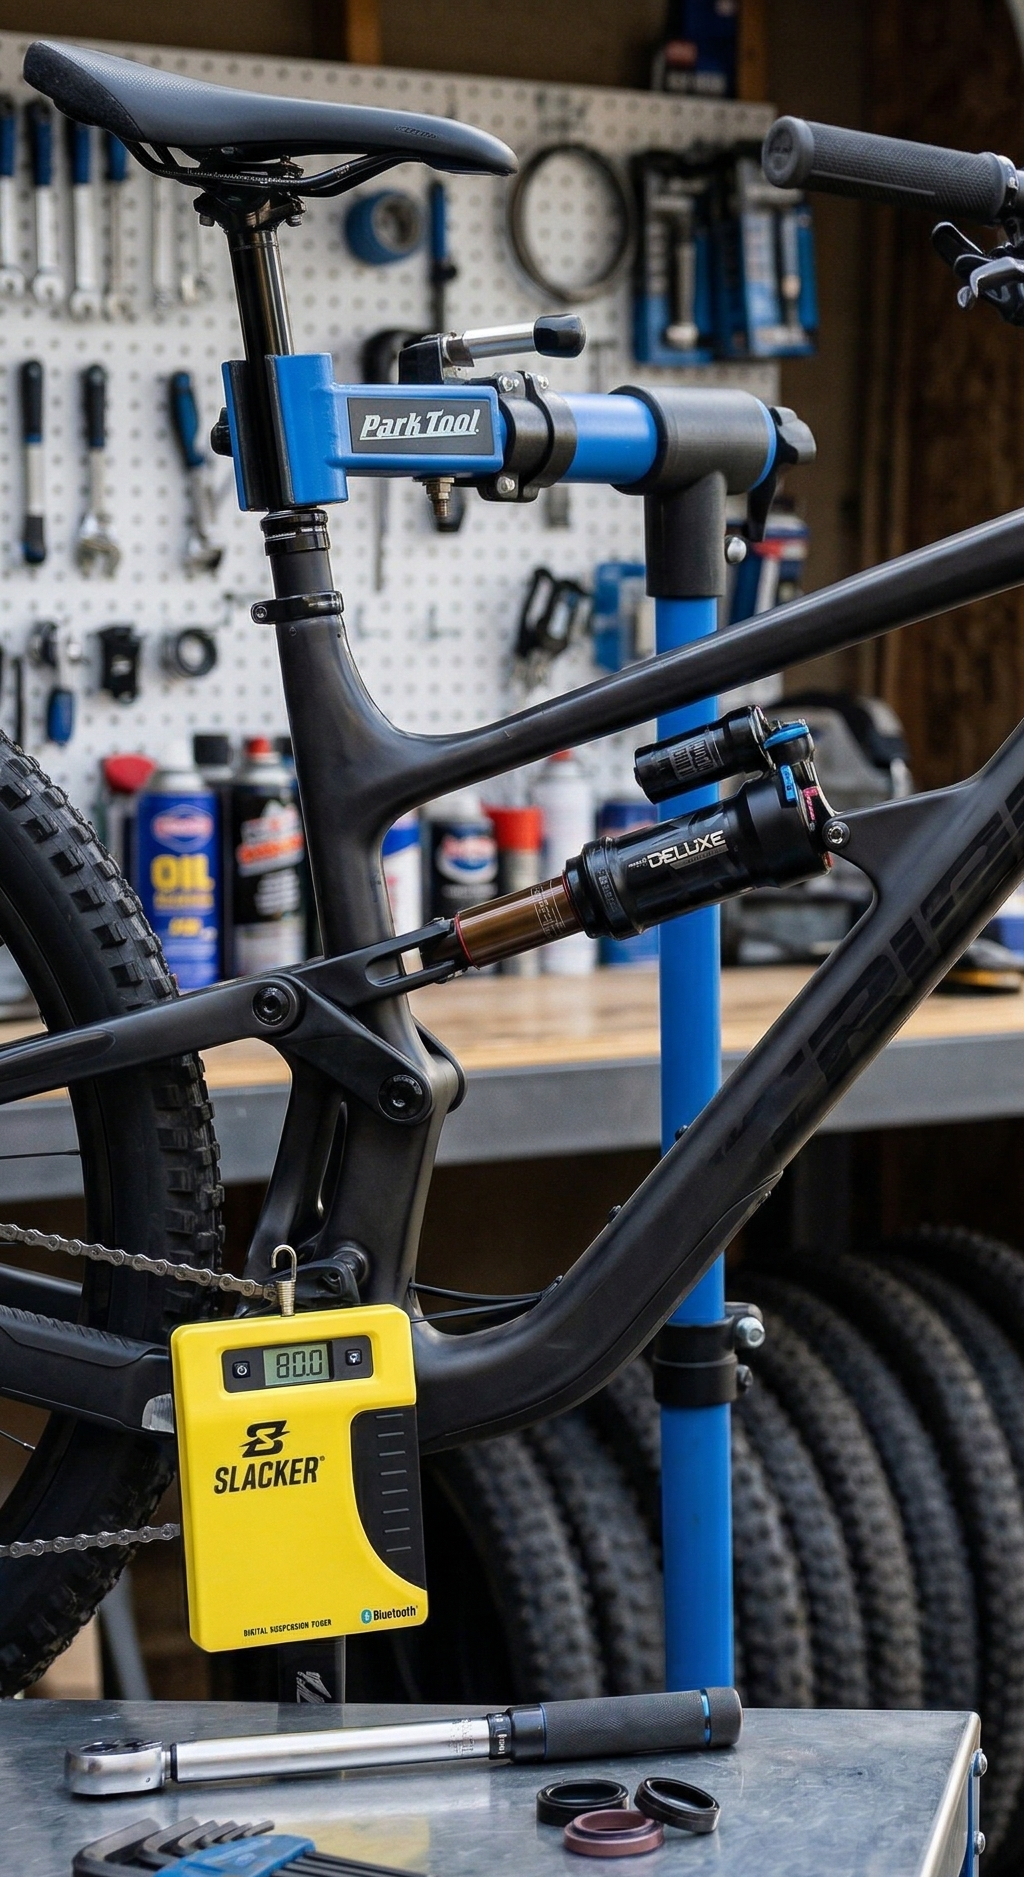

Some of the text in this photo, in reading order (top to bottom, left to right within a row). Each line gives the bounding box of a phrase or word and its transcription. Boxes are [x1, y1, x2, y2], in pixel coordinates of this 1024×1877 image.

[360, 412, 421, 438] Park
[647, 830, 726, 869] DELUXE
[152, 854, 215, 892] OIL
[276, 1349, 323, 1379] 80.0
